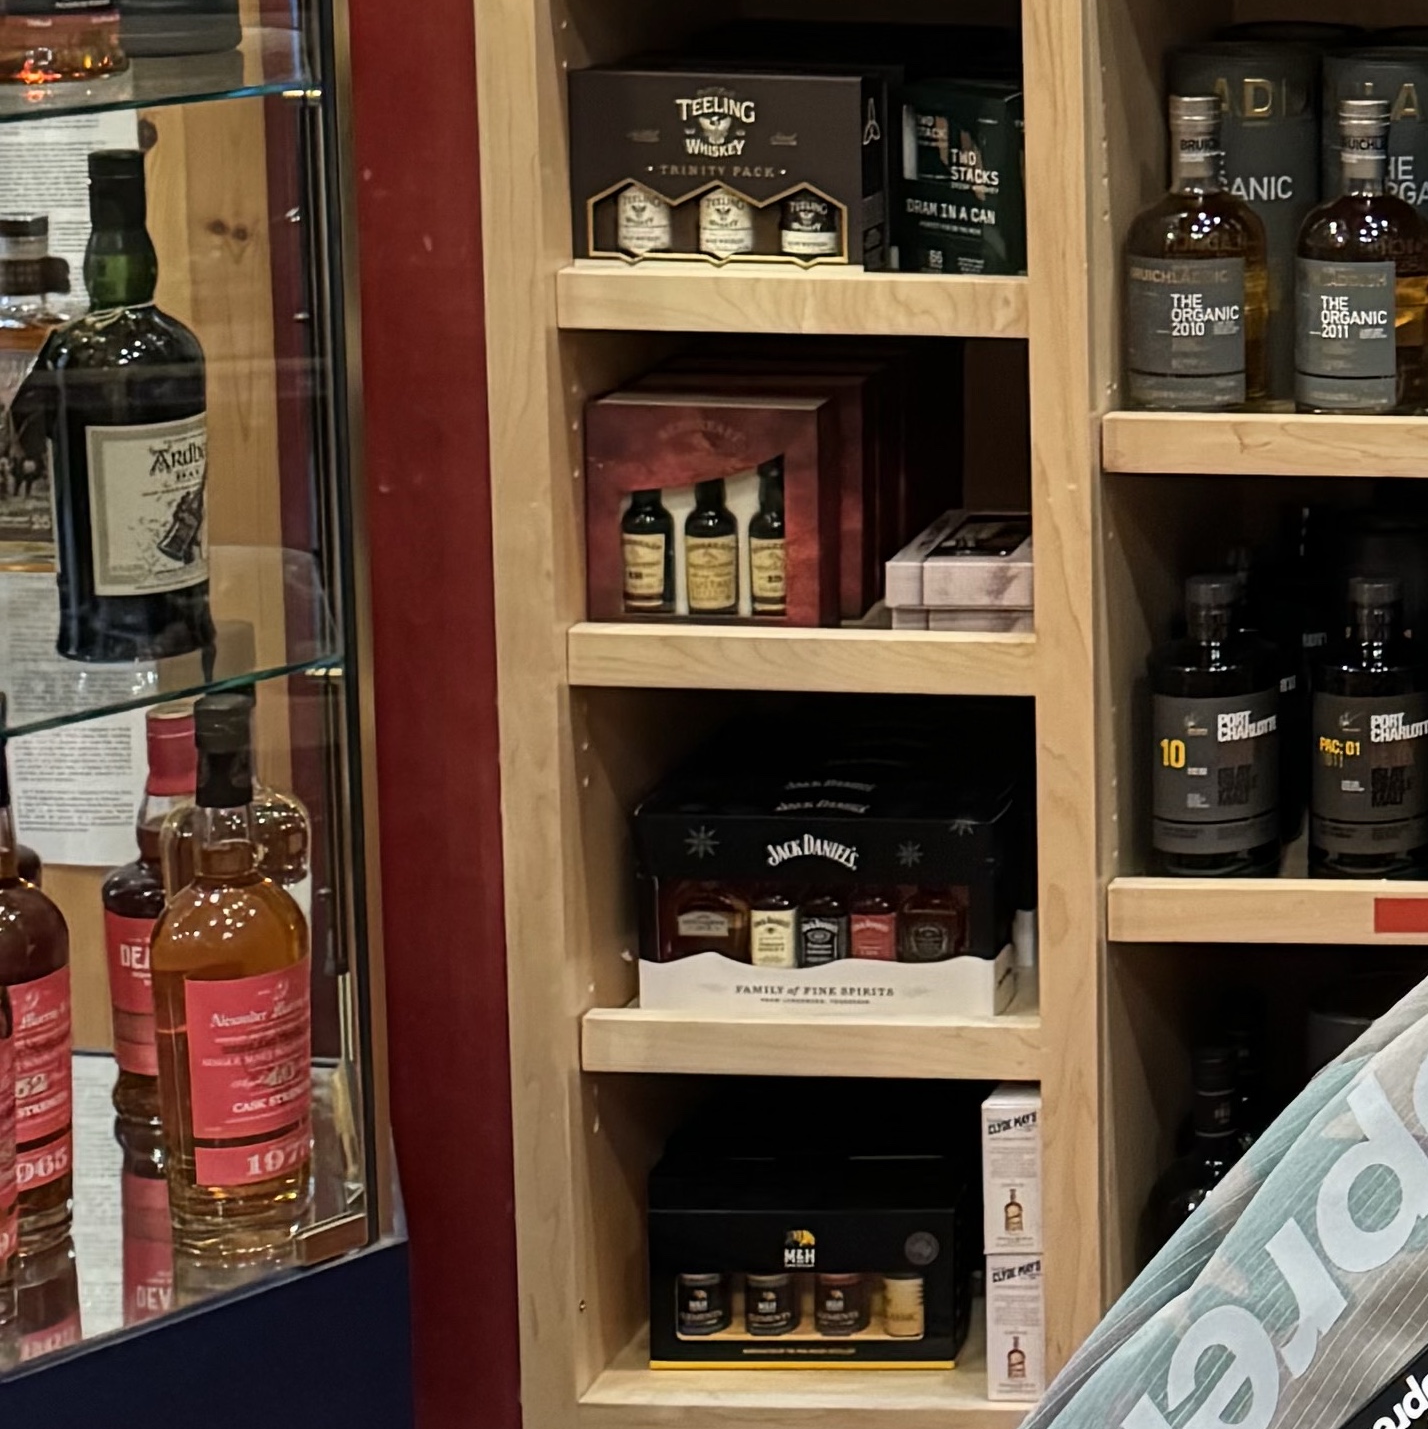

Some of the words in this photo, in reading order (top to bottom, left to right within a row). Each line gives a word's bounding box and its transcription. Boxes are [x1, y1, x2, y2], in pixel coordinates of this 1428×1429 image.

[675, 95, 756, 124] TEELING
[684, 138, 745, 159] WHISKEY
[950, 148, 977, 167] TWO
[659, 164, 727, 178] TRINITY
[732, 165, 776, 179] PACK
[950, 166, 1000, 186] STACKS
[906, 198, 939, 216] DRAM
[970, 206, 996, 226] CAN
[1171, 293, 1203, 308] THE
[1320, 295, 1350, 310] THE
[1171, 305, 1240, 322] ORGANIC
[1320, 309, 1388, 325] ORGANIC
[1171, 322, 1205, 337] 2010
[1320, 324, 1350, 339] 2011
[1217, 710, 1251, 730] PORT
[1370, 712, 1405, 732] PORT
[1160, 738, 1186, 769] 10
[766, 841, 803, 867] JACK
[735, 984, 784, 997] FAMILY
[804, 985, 836, 997] FINE
[840, 985, 894, 998] SPIRITS
[232, 1099, 267, 1114] CASK
